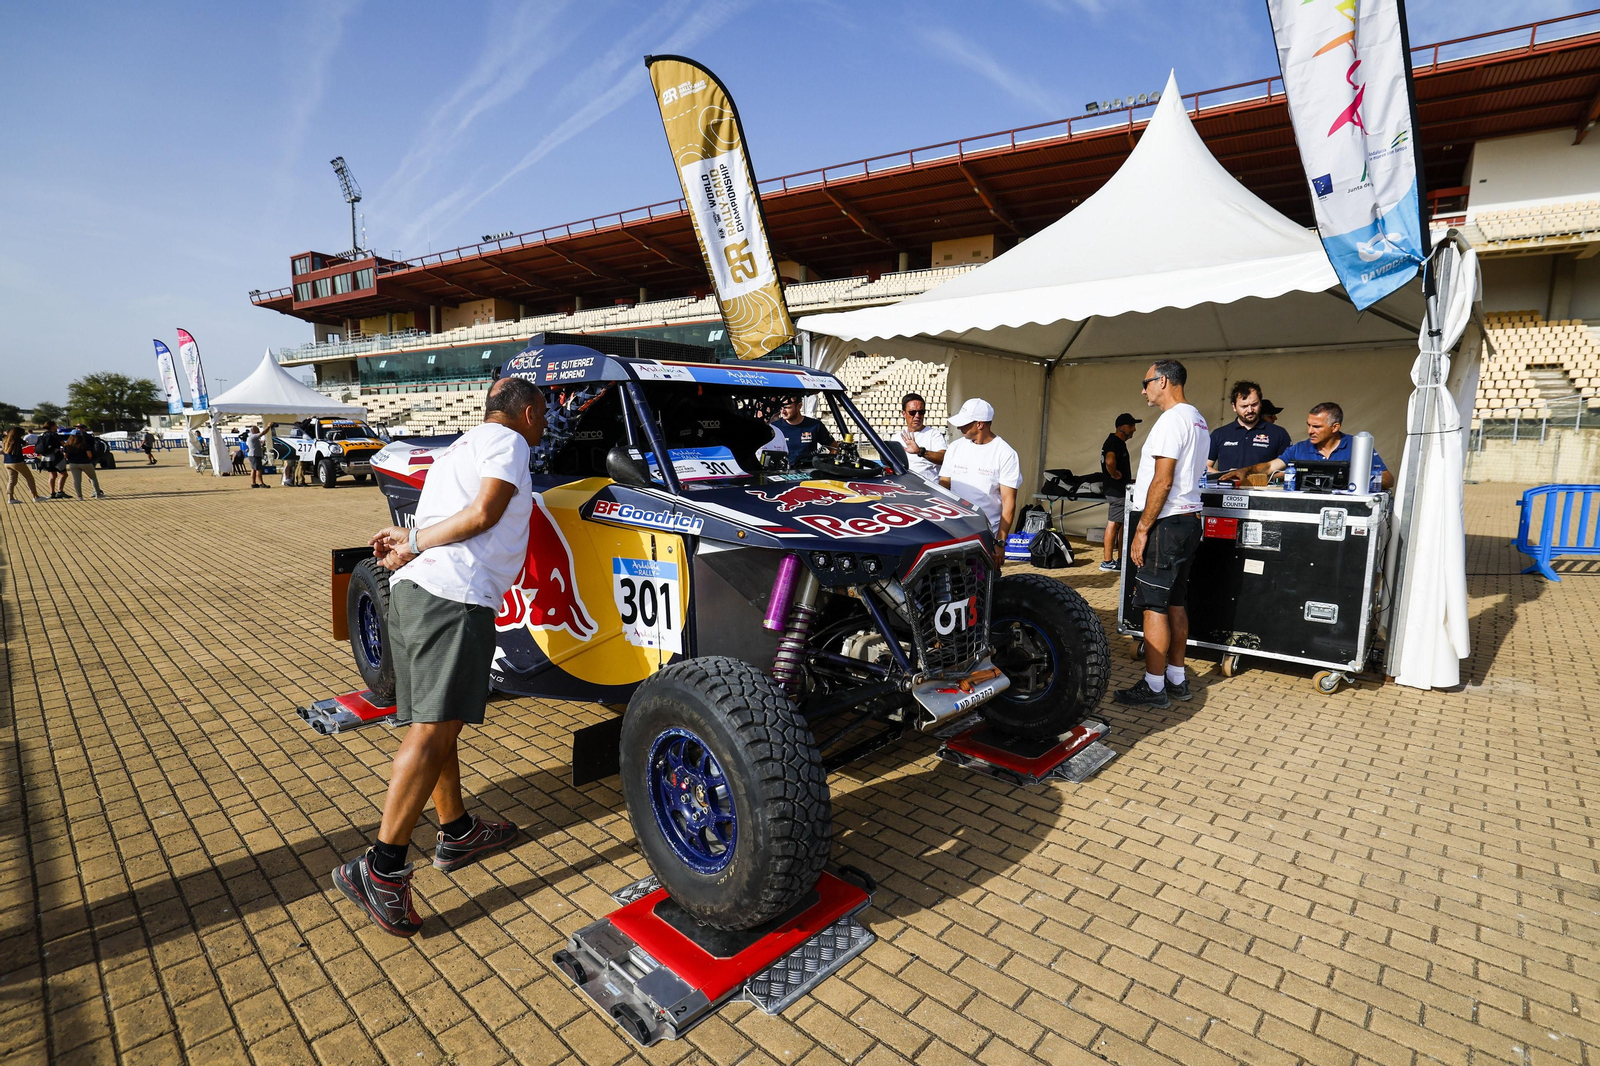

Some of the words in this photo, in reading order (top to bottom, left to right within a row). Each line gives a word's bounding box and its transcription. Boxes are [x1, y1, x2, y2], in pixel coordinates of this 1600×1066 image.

[701, 174, 717, 208] WORLD
[1347, 184, 1363, 194] Junta
[709, 168, 737, 237] RALLY-RAID
[719, 163, 745, 233] CHAMPIONSHIP
[561, 357, 595, 369] GUTIERREZ
[560, 369, 586, 380] MORENO
[740, 378, 764, 386] RALLY
[298, 443, 313, 452] 217
[700, 461, 735, 475] 301
[594, 500, 703, 529] BFGoodrich
[620, 577, 673, 631] 301
[674, 1006, 688, 1017] 2
